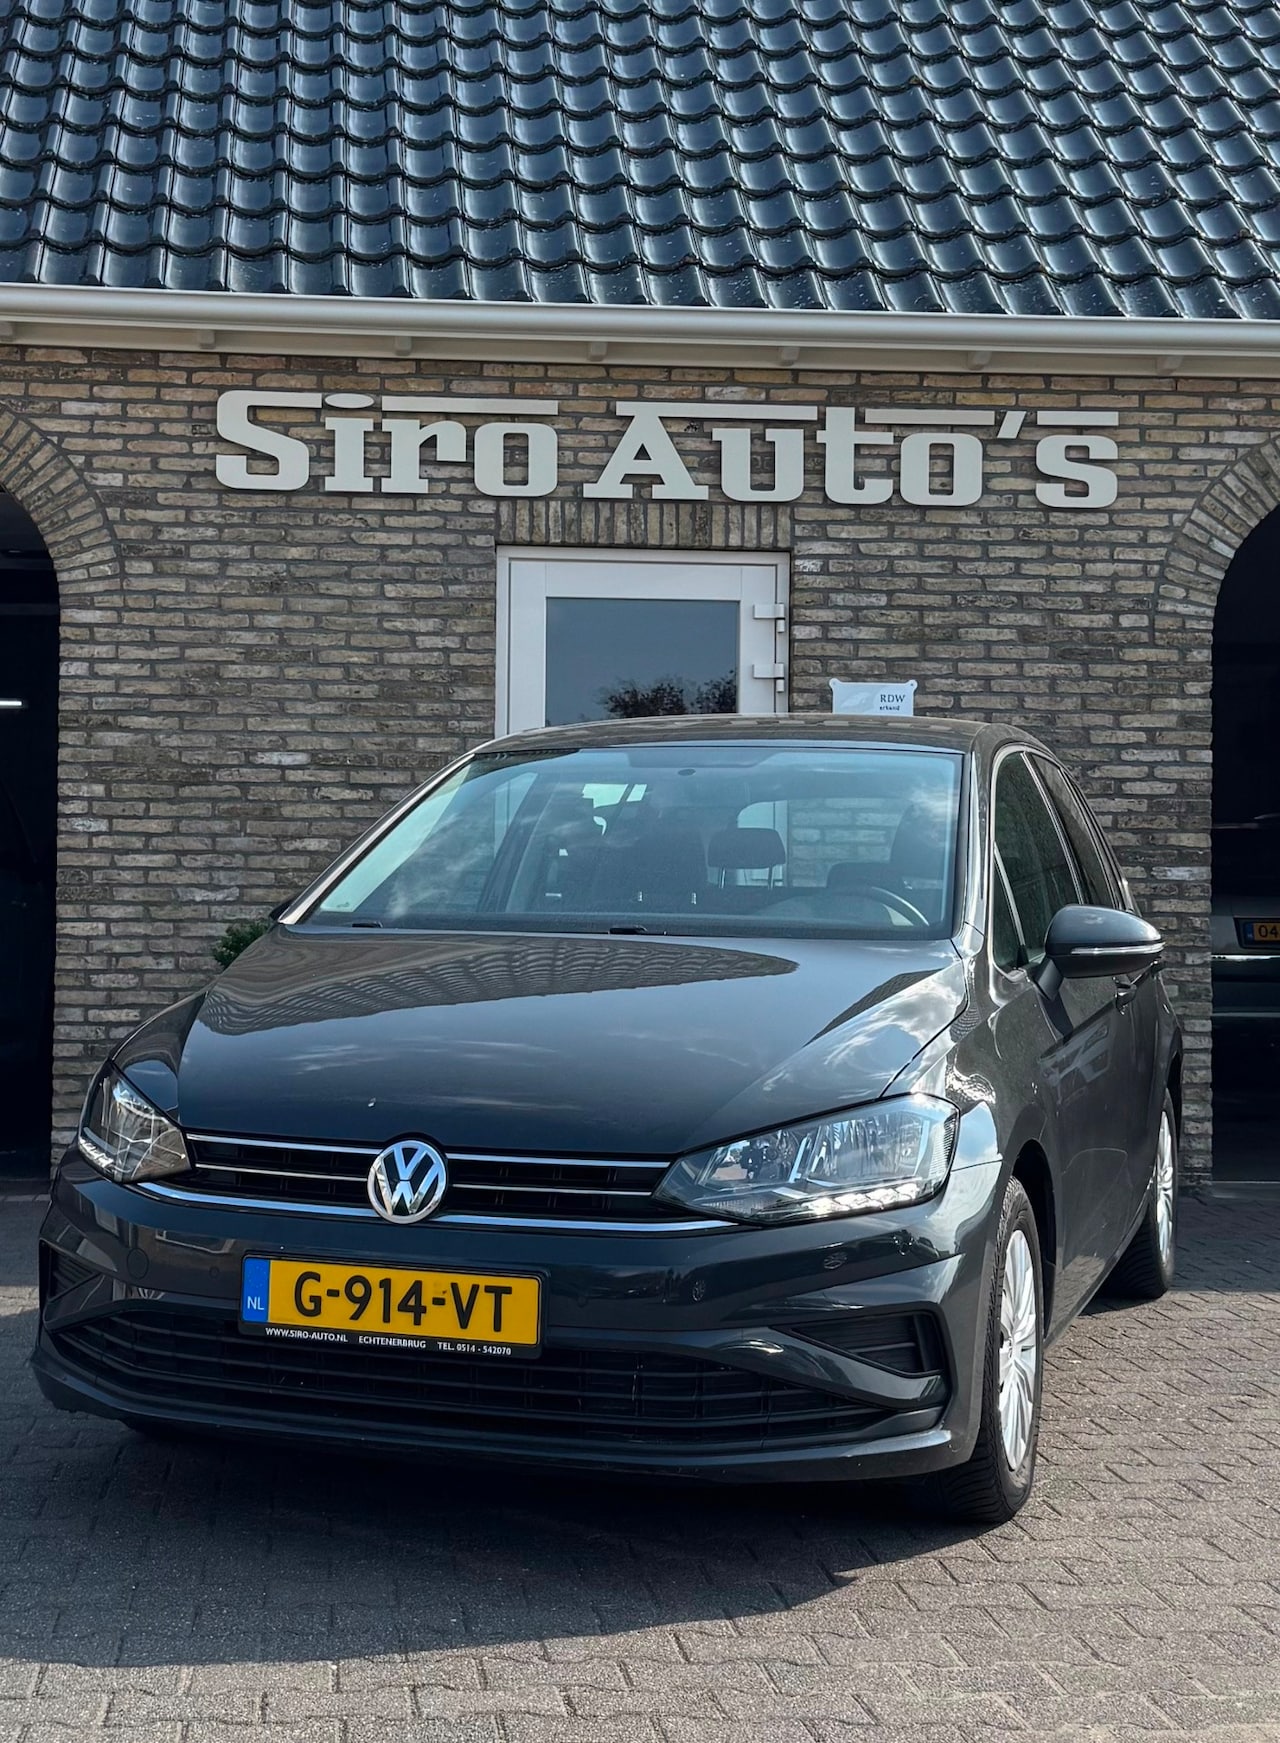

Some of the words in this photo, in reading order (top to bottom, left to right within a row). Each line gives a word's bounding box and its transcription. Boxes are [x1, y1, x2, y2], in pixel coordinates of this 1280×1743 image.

[216, 390, 559, 497] Siro
[583, 401, 1119, 508] Auto's
[880, 694, 905, 703] RDW
[247, 1296, 265, 1311] NL
[294, 1271, 513, 1333] G-914-VT
[265, 1327, 349, 1343] WWW.SIRO-AUTO.NL
[358, 1335, 427, 1349] ECHTENERBRUG
[437, 1341, 455, 1351] TEL.
[456, 1343, 476, 1353] 0514
[482, 1345, 512, 1356] 542070
